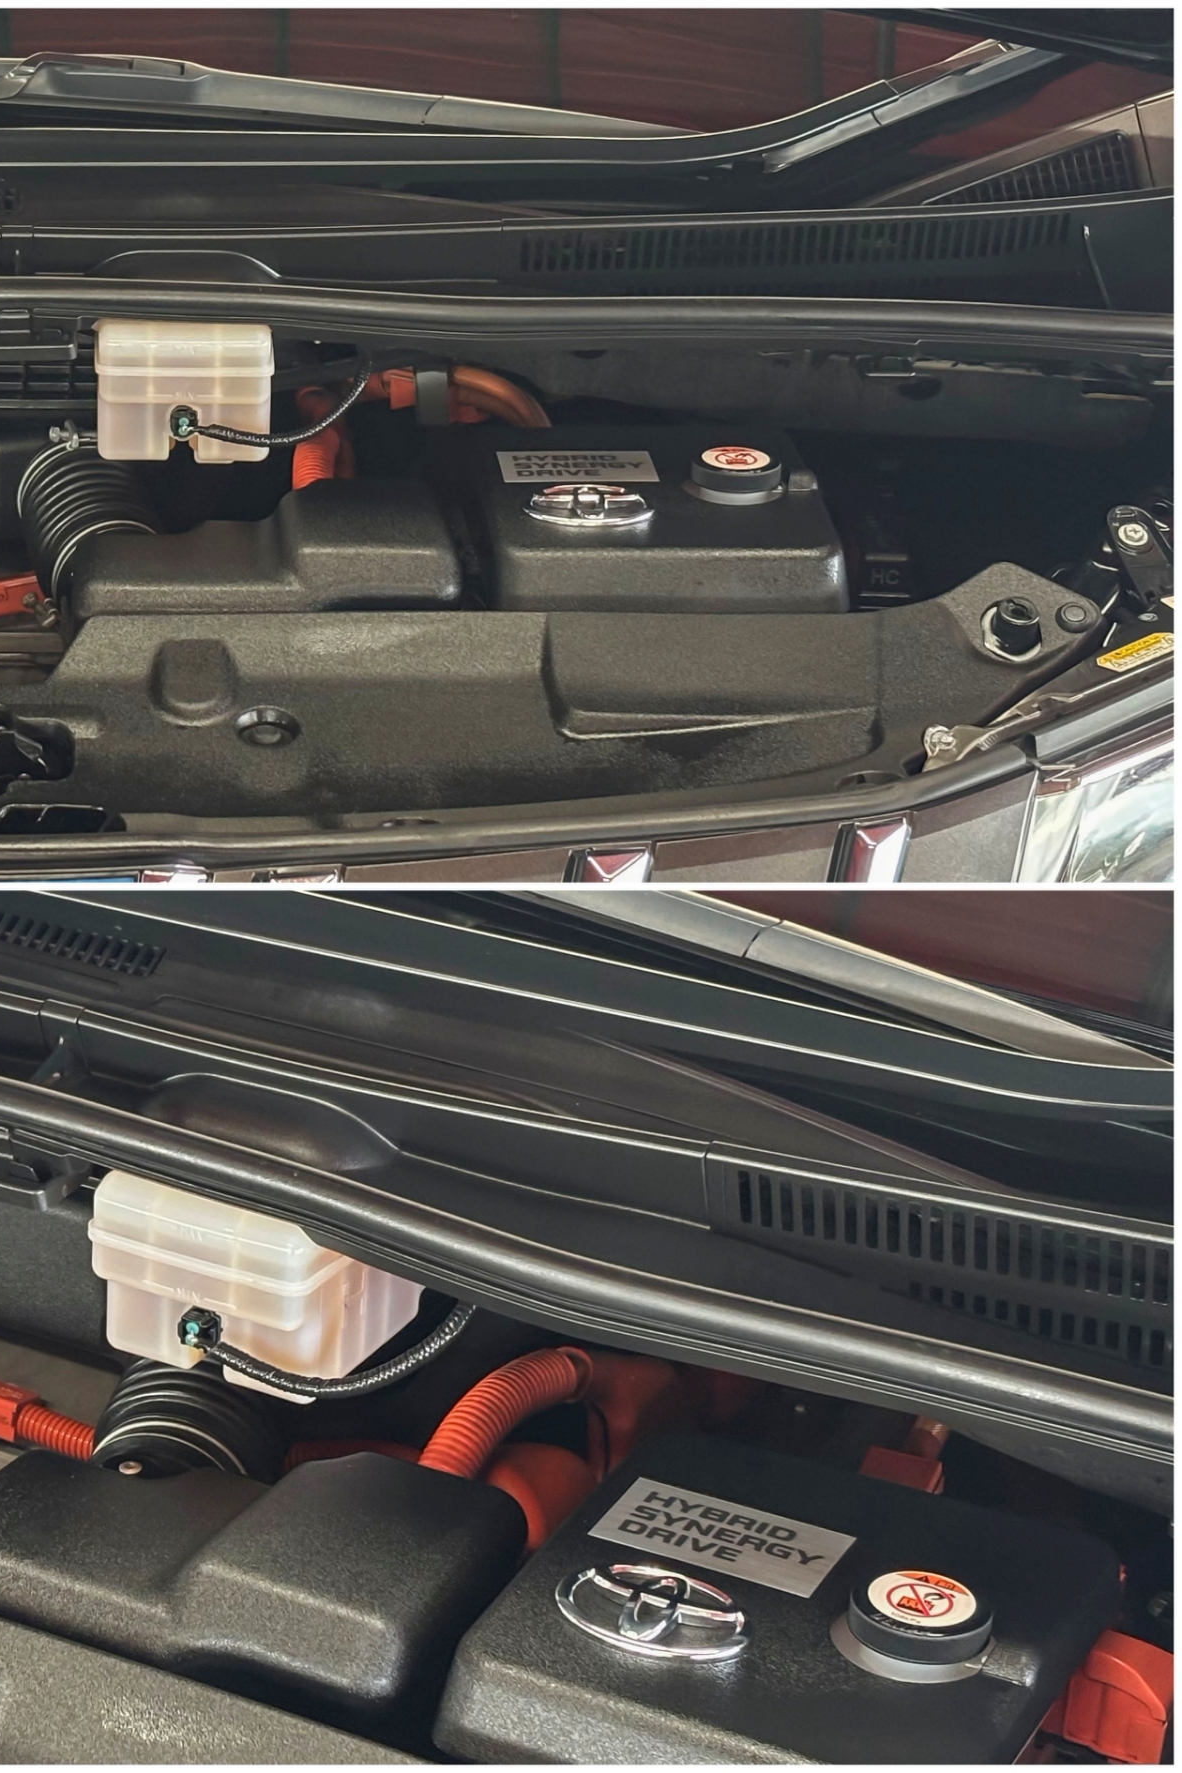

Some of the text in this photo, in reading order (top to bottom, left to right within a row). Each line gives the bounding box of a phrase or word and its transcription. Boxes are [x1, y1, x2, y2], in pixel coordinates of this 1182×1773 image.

[512, 454, 617, 462] HYBRID
[514, 461, 647, 469] SYNERGY
[516, 469, 602, 477] DRIVE
[643, 1491, 798, 1542] HYBRID
[617, 1518, 743, 1562] DRIVE
[629, 1504, 825, 1566] SYNERGY
